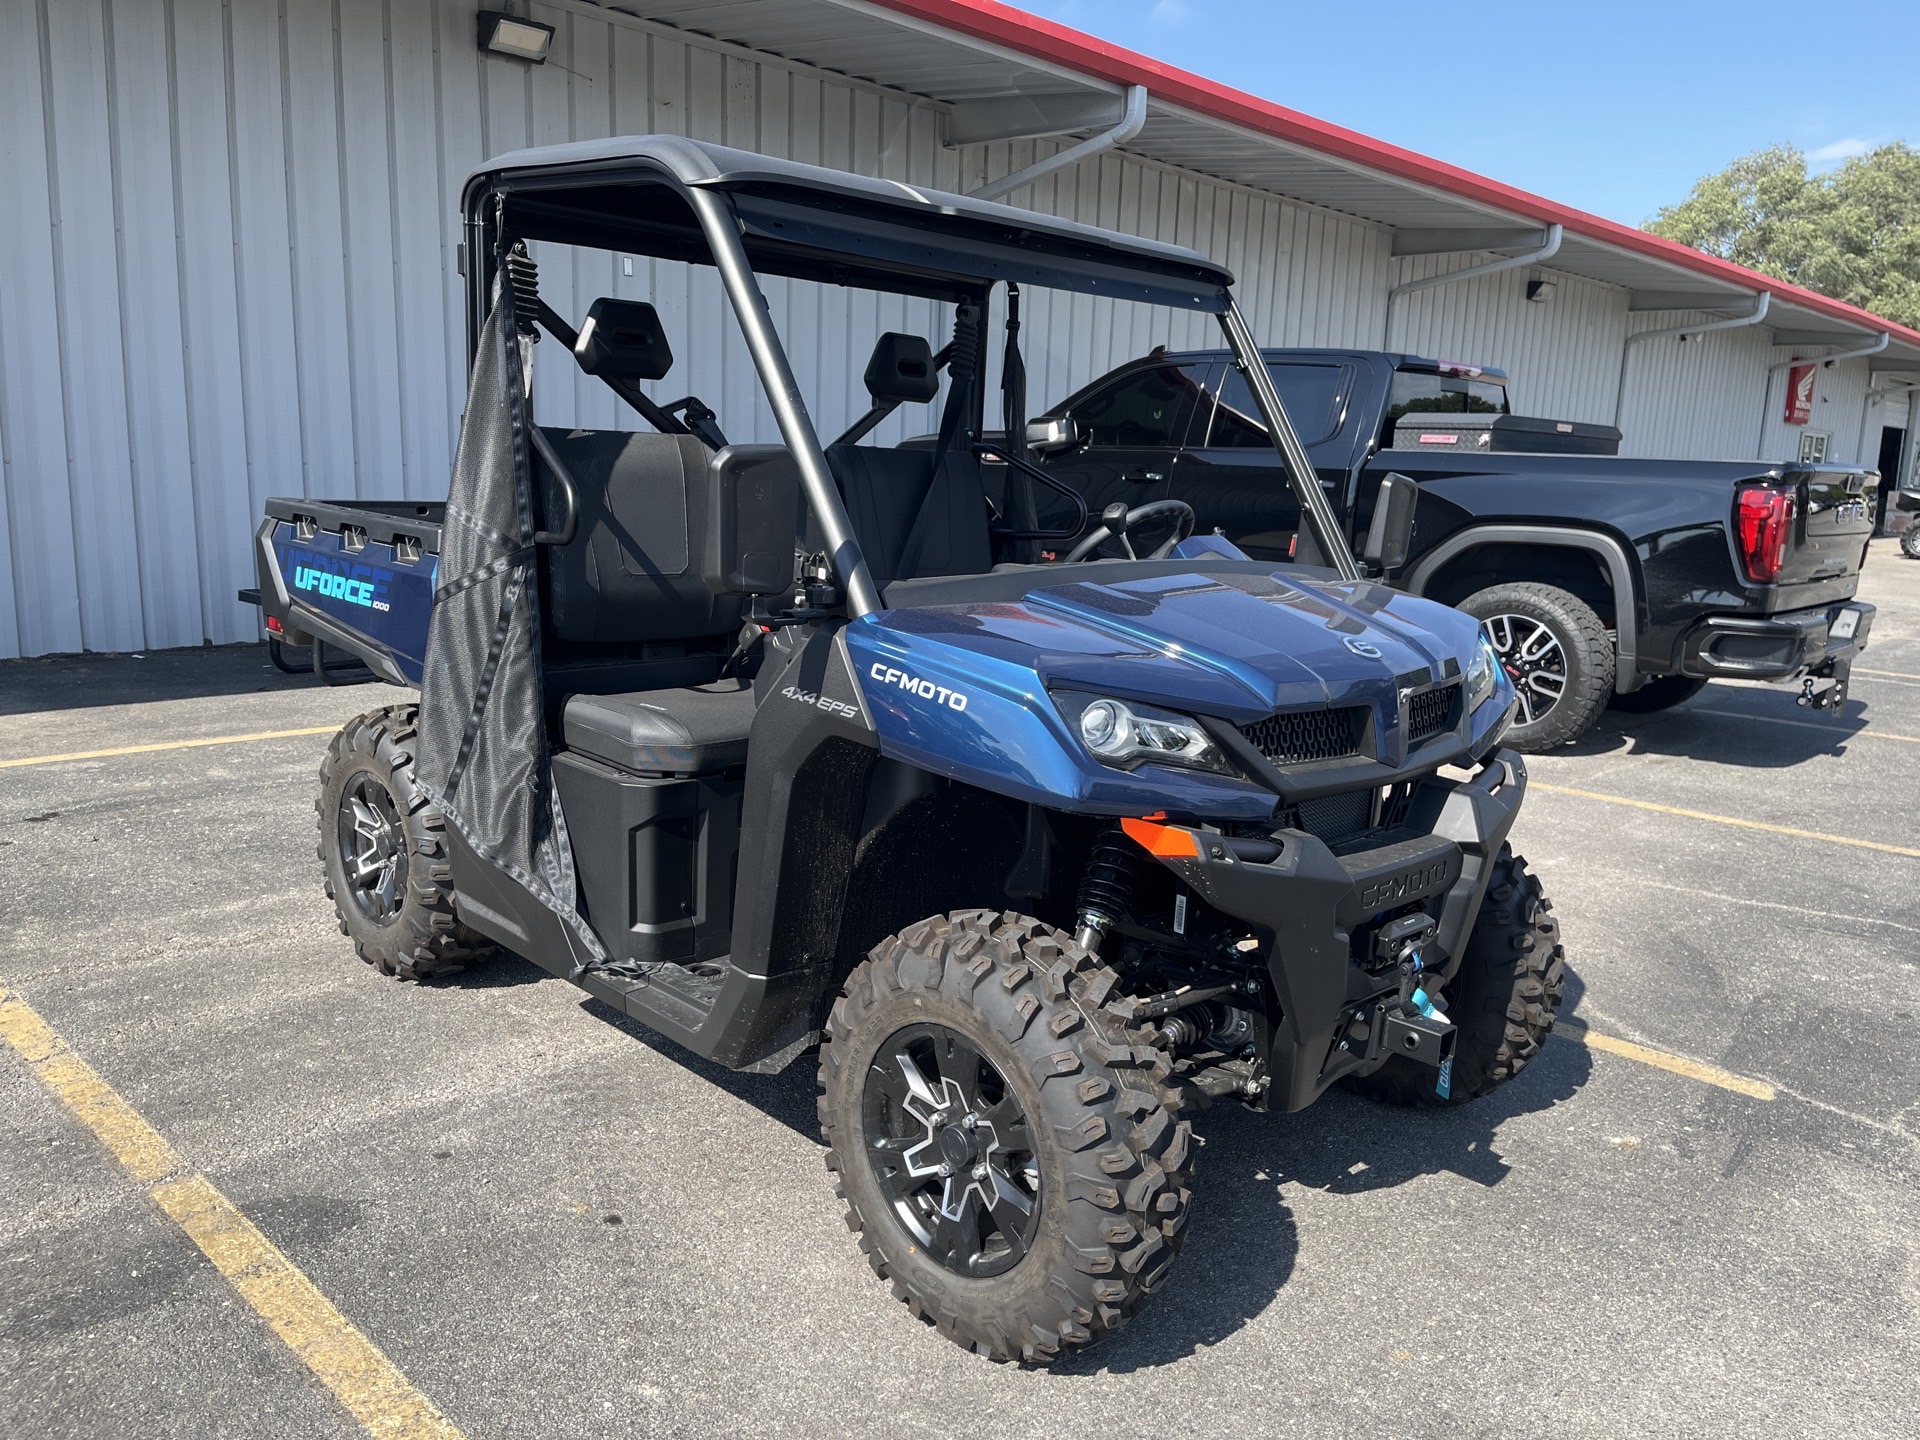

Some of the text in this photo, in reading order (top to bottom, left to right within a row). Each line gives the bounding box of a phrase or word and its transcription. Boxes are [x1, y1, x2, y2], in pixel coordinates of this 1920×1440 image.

[294, 565, 390, 612] UFORCE 1000
[816, 696, 859, 718] EPS
[870, 662, 968, 712] CFMOTO
[1362, 860, 1447, 909] CFMOTO
